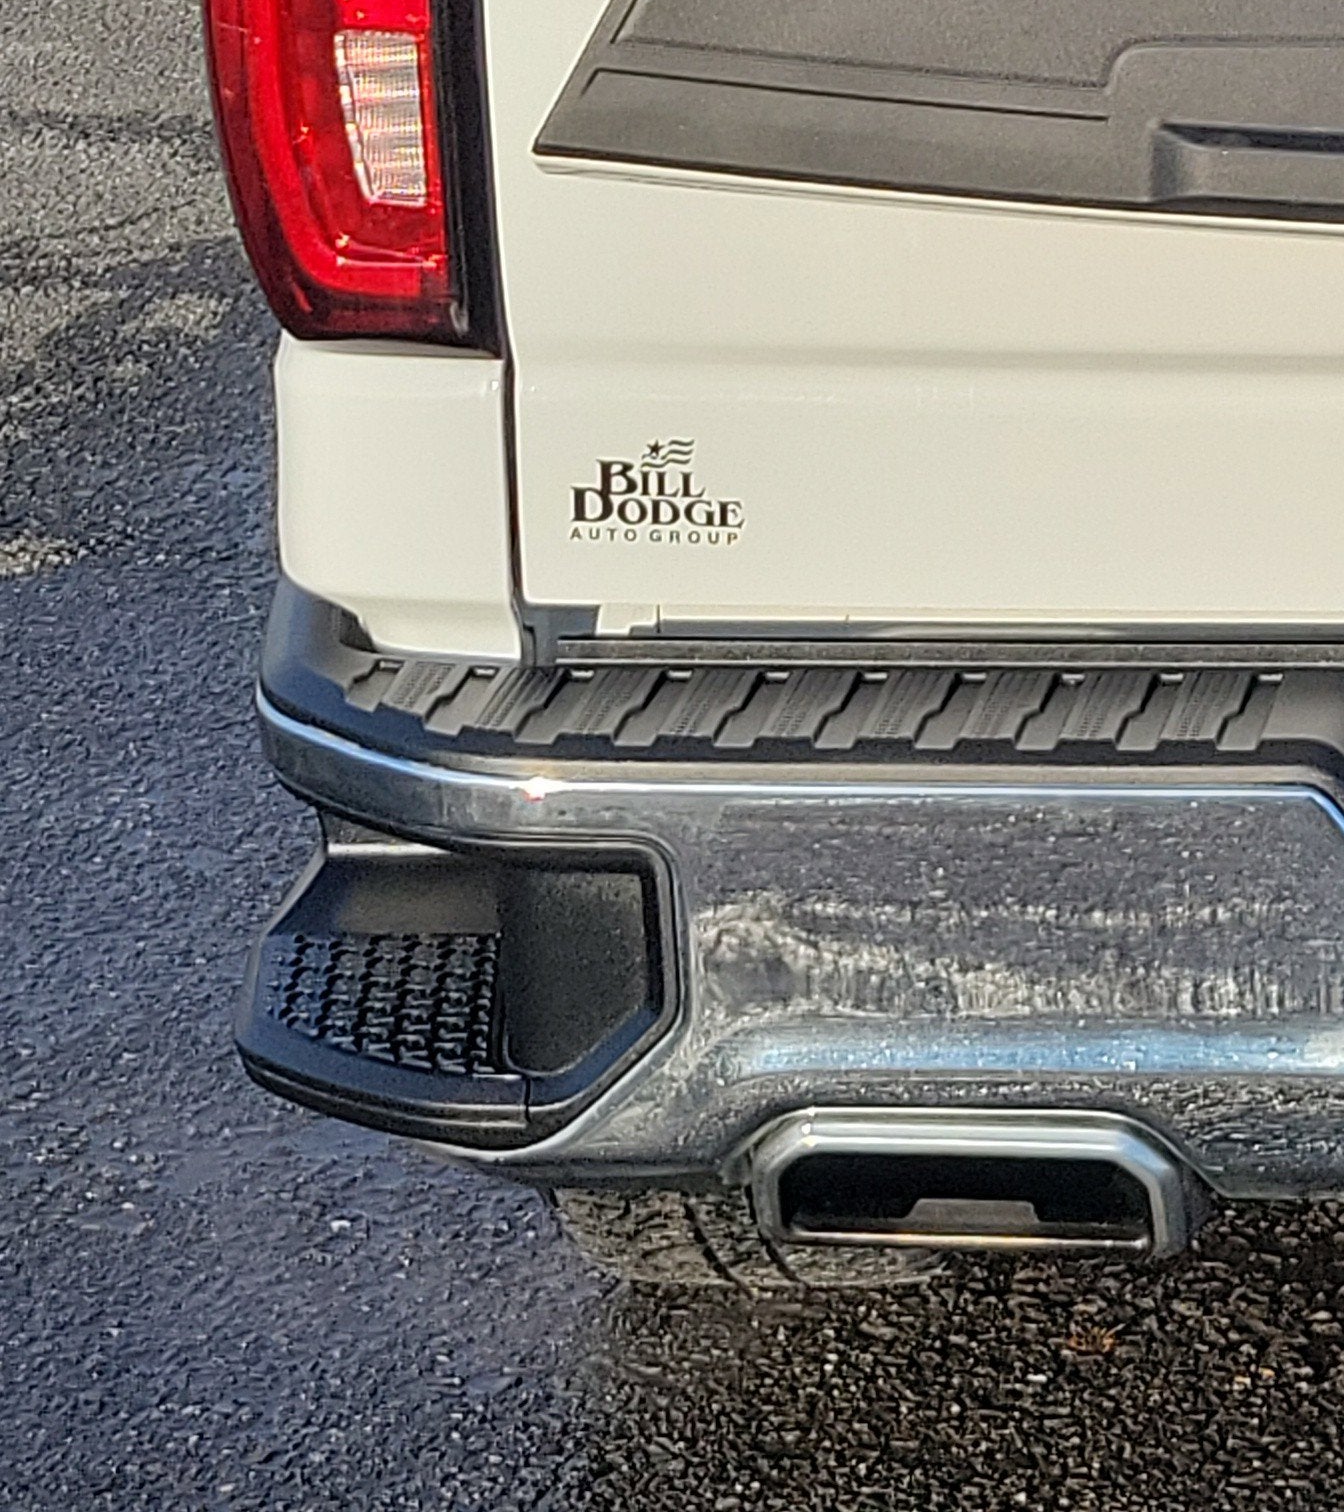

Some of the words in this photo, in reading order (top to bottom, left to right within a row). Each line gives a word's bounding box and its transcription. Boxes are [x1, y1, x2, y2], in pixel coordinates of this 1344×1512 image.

[596, 458, 706, 498] BILL
[570, 486, 745, 529] DODGE
[570, 526, 637, 542] AUTO
[649, 528, 738, 545] GROUP
